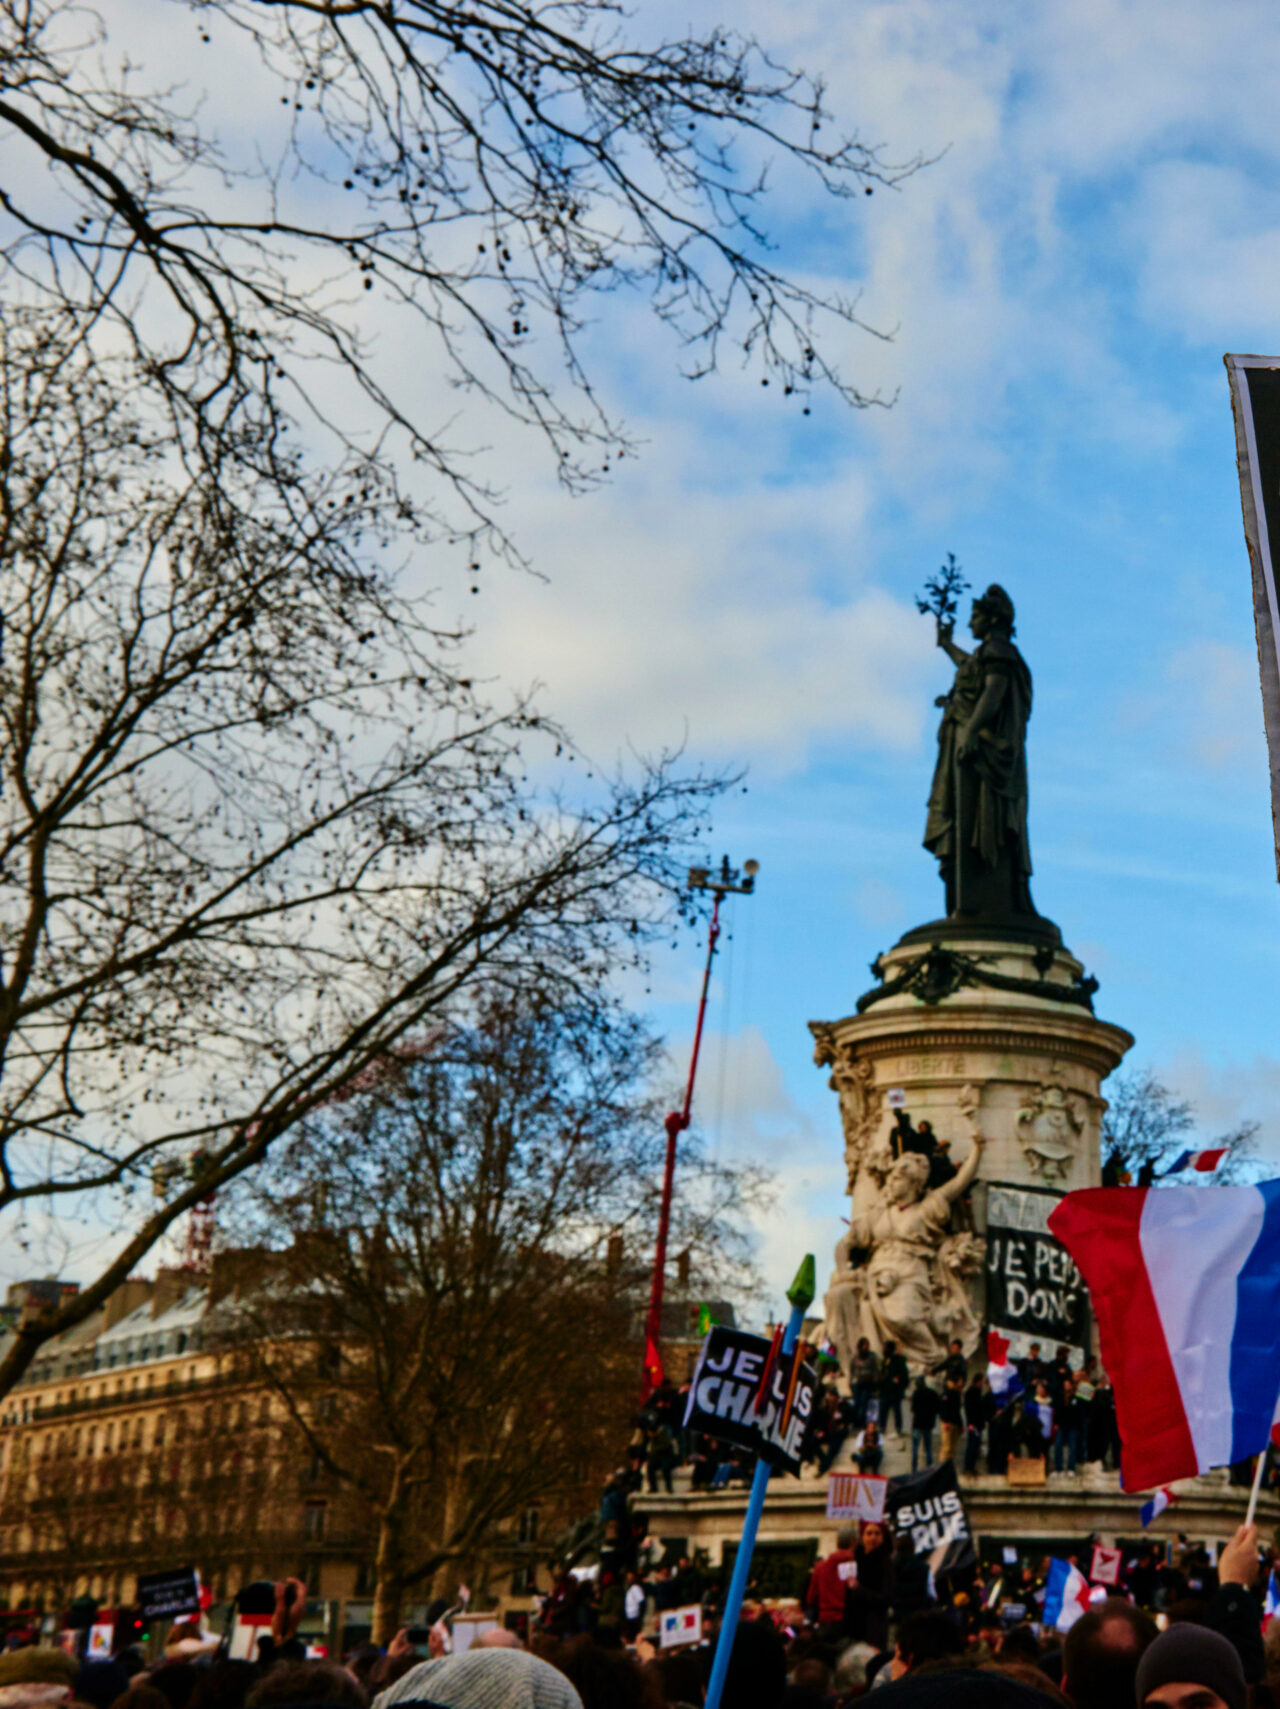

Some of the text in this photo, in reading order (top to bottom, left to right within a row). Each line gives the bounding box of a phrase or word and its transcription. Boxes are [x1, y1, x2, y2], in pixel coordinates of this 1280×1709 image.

[989, 1239, 1027, 1279] JE
[1006, 1281, 1077, 1323] DONC
[706, 1346, 764, 1383] JE
[897, 1490, 961, 1528] SUIS
